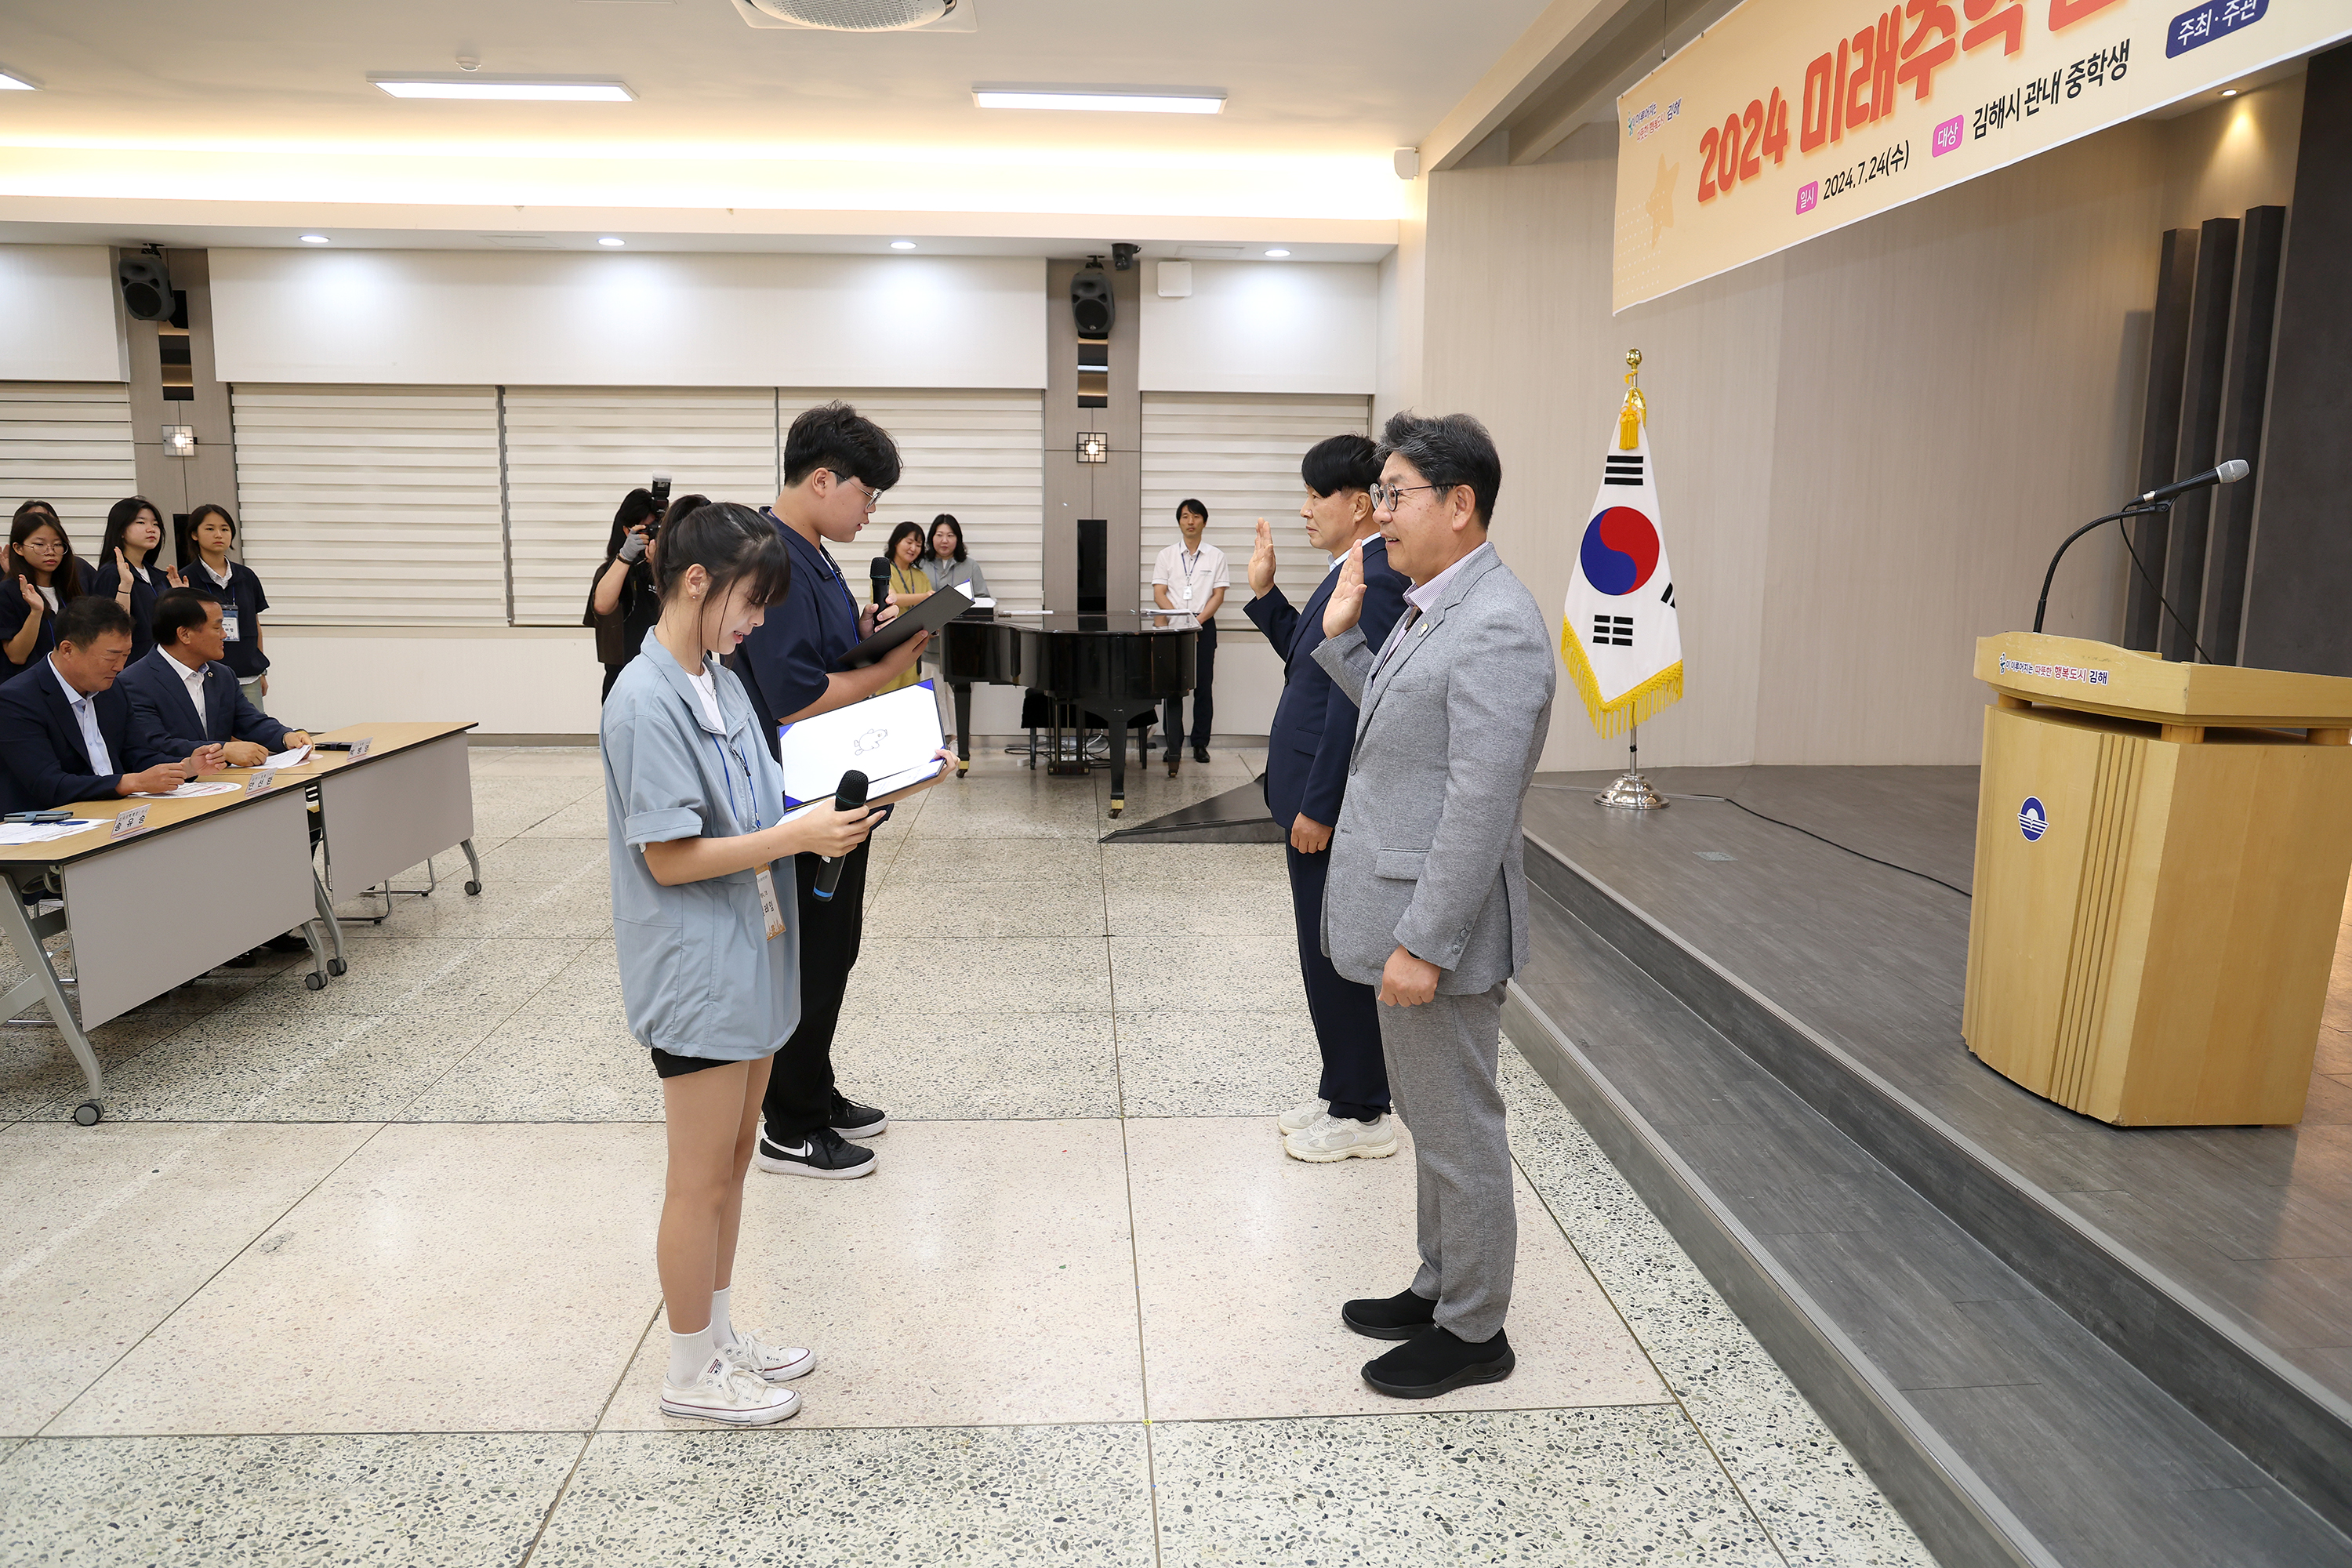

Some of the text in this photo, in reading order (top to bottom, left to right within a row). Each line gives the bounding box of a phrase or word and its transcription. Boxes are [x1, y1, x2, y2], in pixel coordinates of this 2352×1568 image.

[1667, 98, 1682, 122] 김해
[1936, 38, 2131, 148] 대상 김해시 관내 중학생
[1698, 86, 1788, 202] 2024
[1800, 140, 1910, 209] 일시 2024.7.24(수)
[2034, 665, 2053, 677] 따뜻한
[2054, 666, 2087, 682] 행복도시
[2089, 670, 2107, 684] 김해
